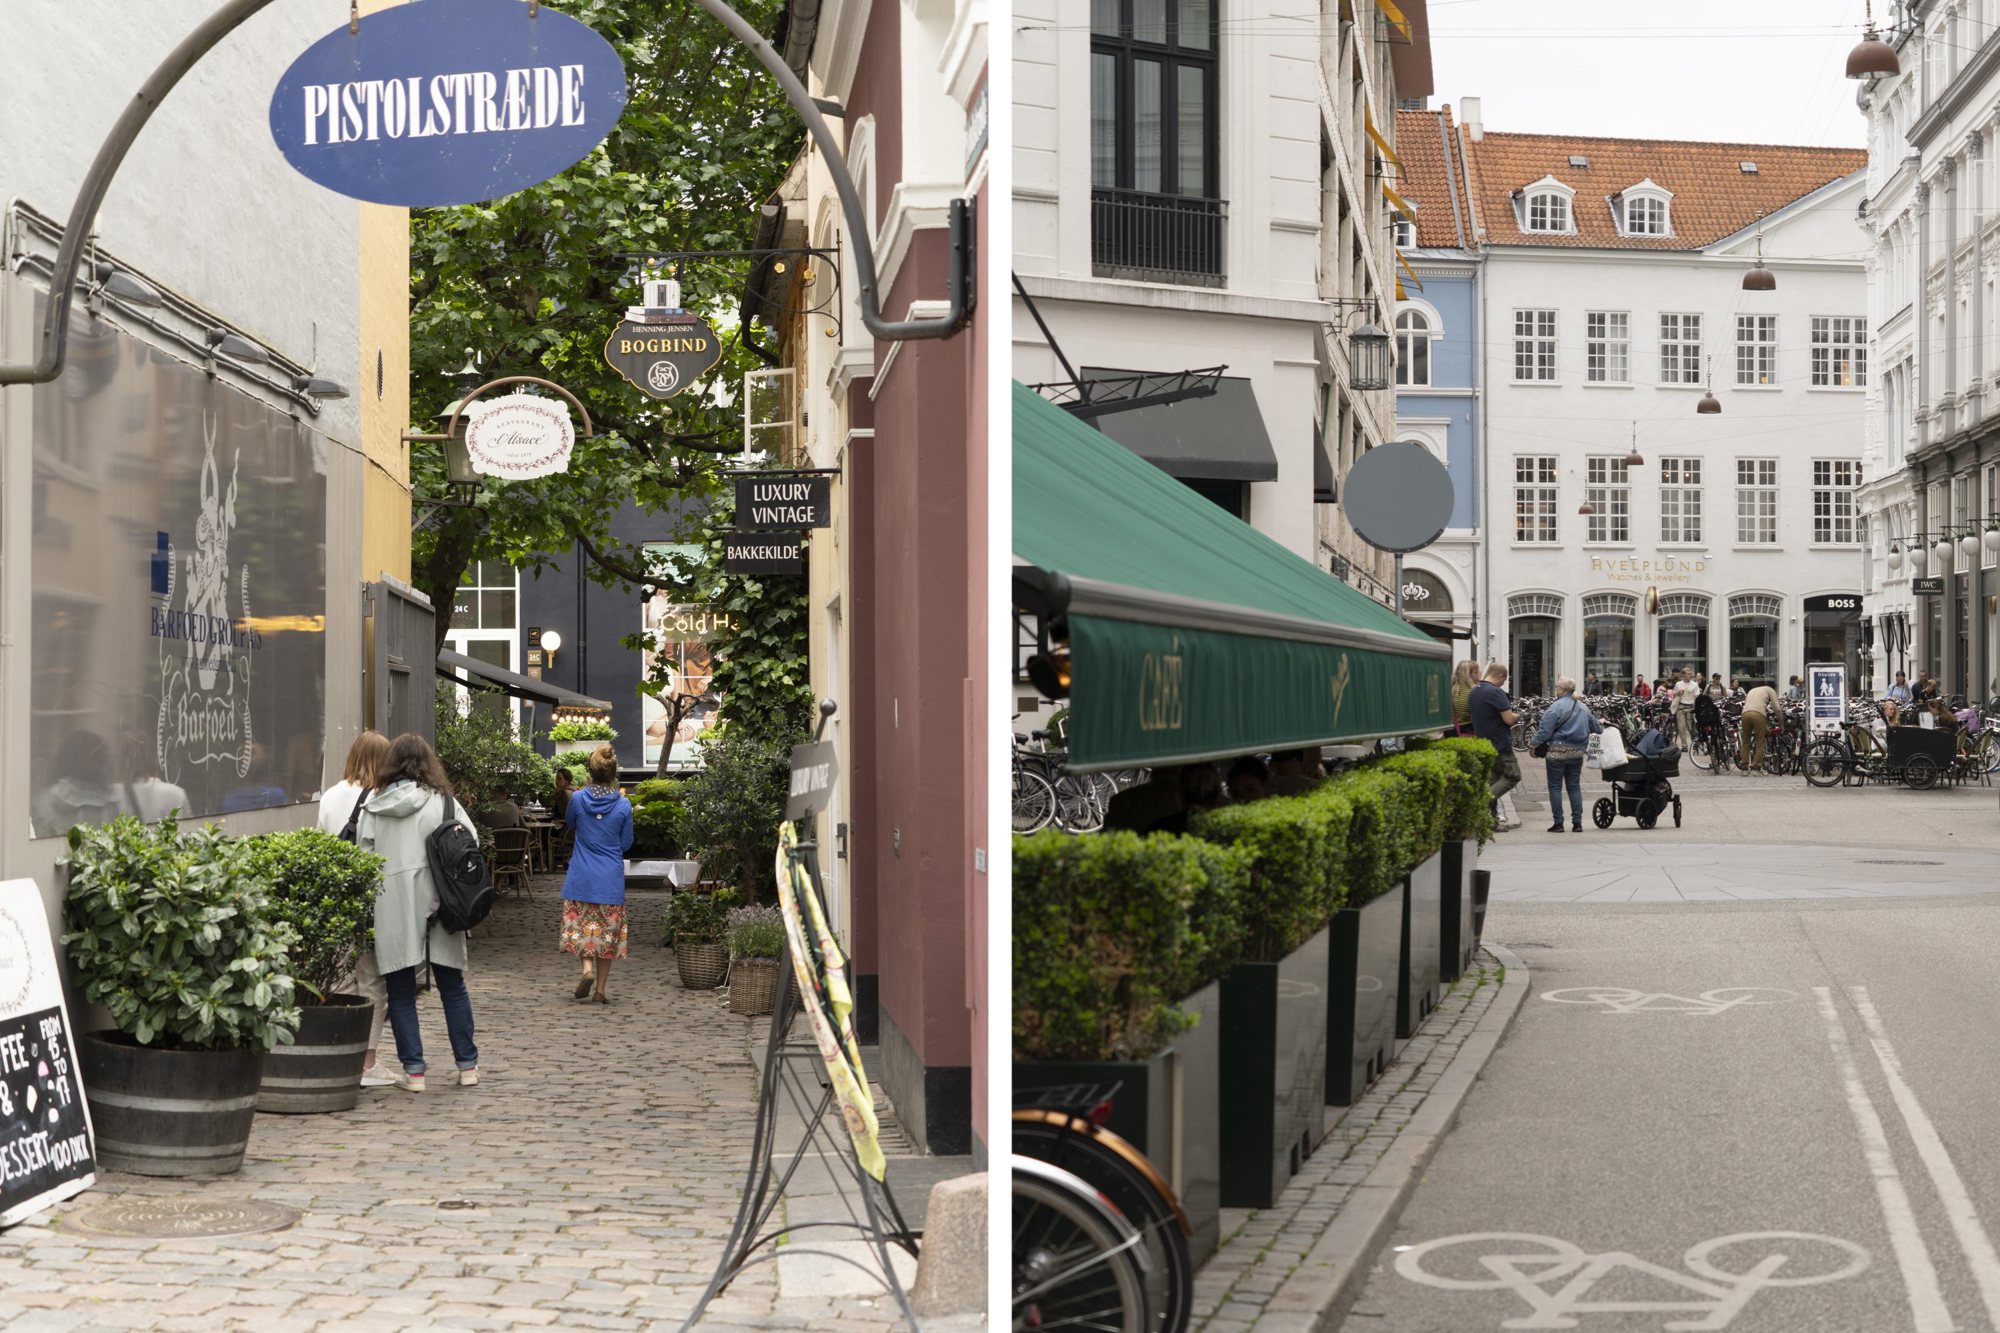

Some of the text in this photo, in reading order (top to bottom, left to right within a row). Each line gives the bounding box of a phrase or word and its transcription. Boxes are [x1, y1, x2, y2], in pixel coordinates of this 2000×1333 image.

[303, 64, 585, 145] PISTOLSTRÆDE
[667, 325, 694, 333] JENSEN
[621, 338, 707, 354] BOGBIND
[497, 419, 545, 430] RESTAURANT
[754, 483, 811, 502] LUXURY
[752, 506, 815, 523] VINTAGE
[727, 545, 799, 560] BAKKEKILDE
[1591, 559, 1706, 572] HVELPLUND
[1607, 573, 1691, 583] Watches & Jewellery
[1920, 581, 1937, 589] IWC
[454, 605, 469, 613] 24 C
[1828, 598, 1855, 608] BOSS
[151, 606, 206, 643] BARFOED
[660, 613, 706, 632] Cold
[1138, 634, 1182, 731] CAFÉ
[175, 691, 238, 770] Barfoed
[39, 1015, 62, 1041] FROM
[54, 1057, 67, 1075] TO
[56, 1075, 71, 1106] 17
[50, 1140, 71, 1172] 100
[68, 1134, 90, 1165] DKK
